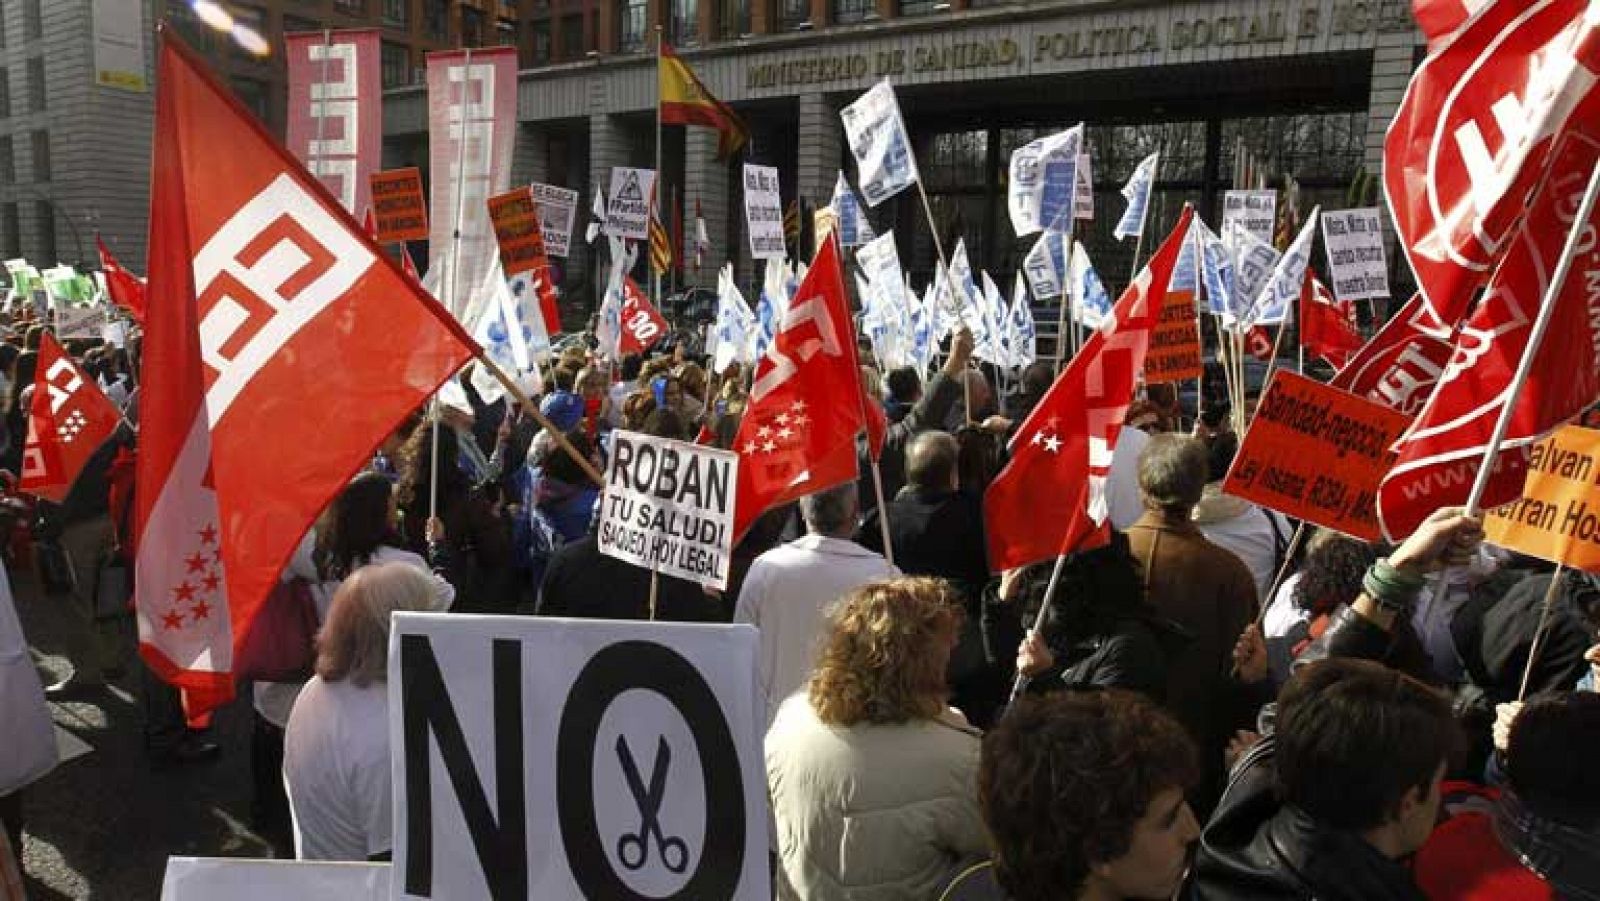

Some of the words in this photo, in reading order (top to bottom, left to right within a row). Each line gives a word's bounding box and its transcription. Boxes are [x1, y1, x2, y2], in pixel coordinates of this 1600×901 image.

[746, 53, 868, 89] MINISTERIO
[876, 49, 905, 75] DE
[610, 437, 730, 514] ROBAN
[1528, 437, 1594, 483] alvan
[609, 493, 635, 522] TU
[650, 535, 679, 567] HOY
[401, 633, 747, 901] NO
